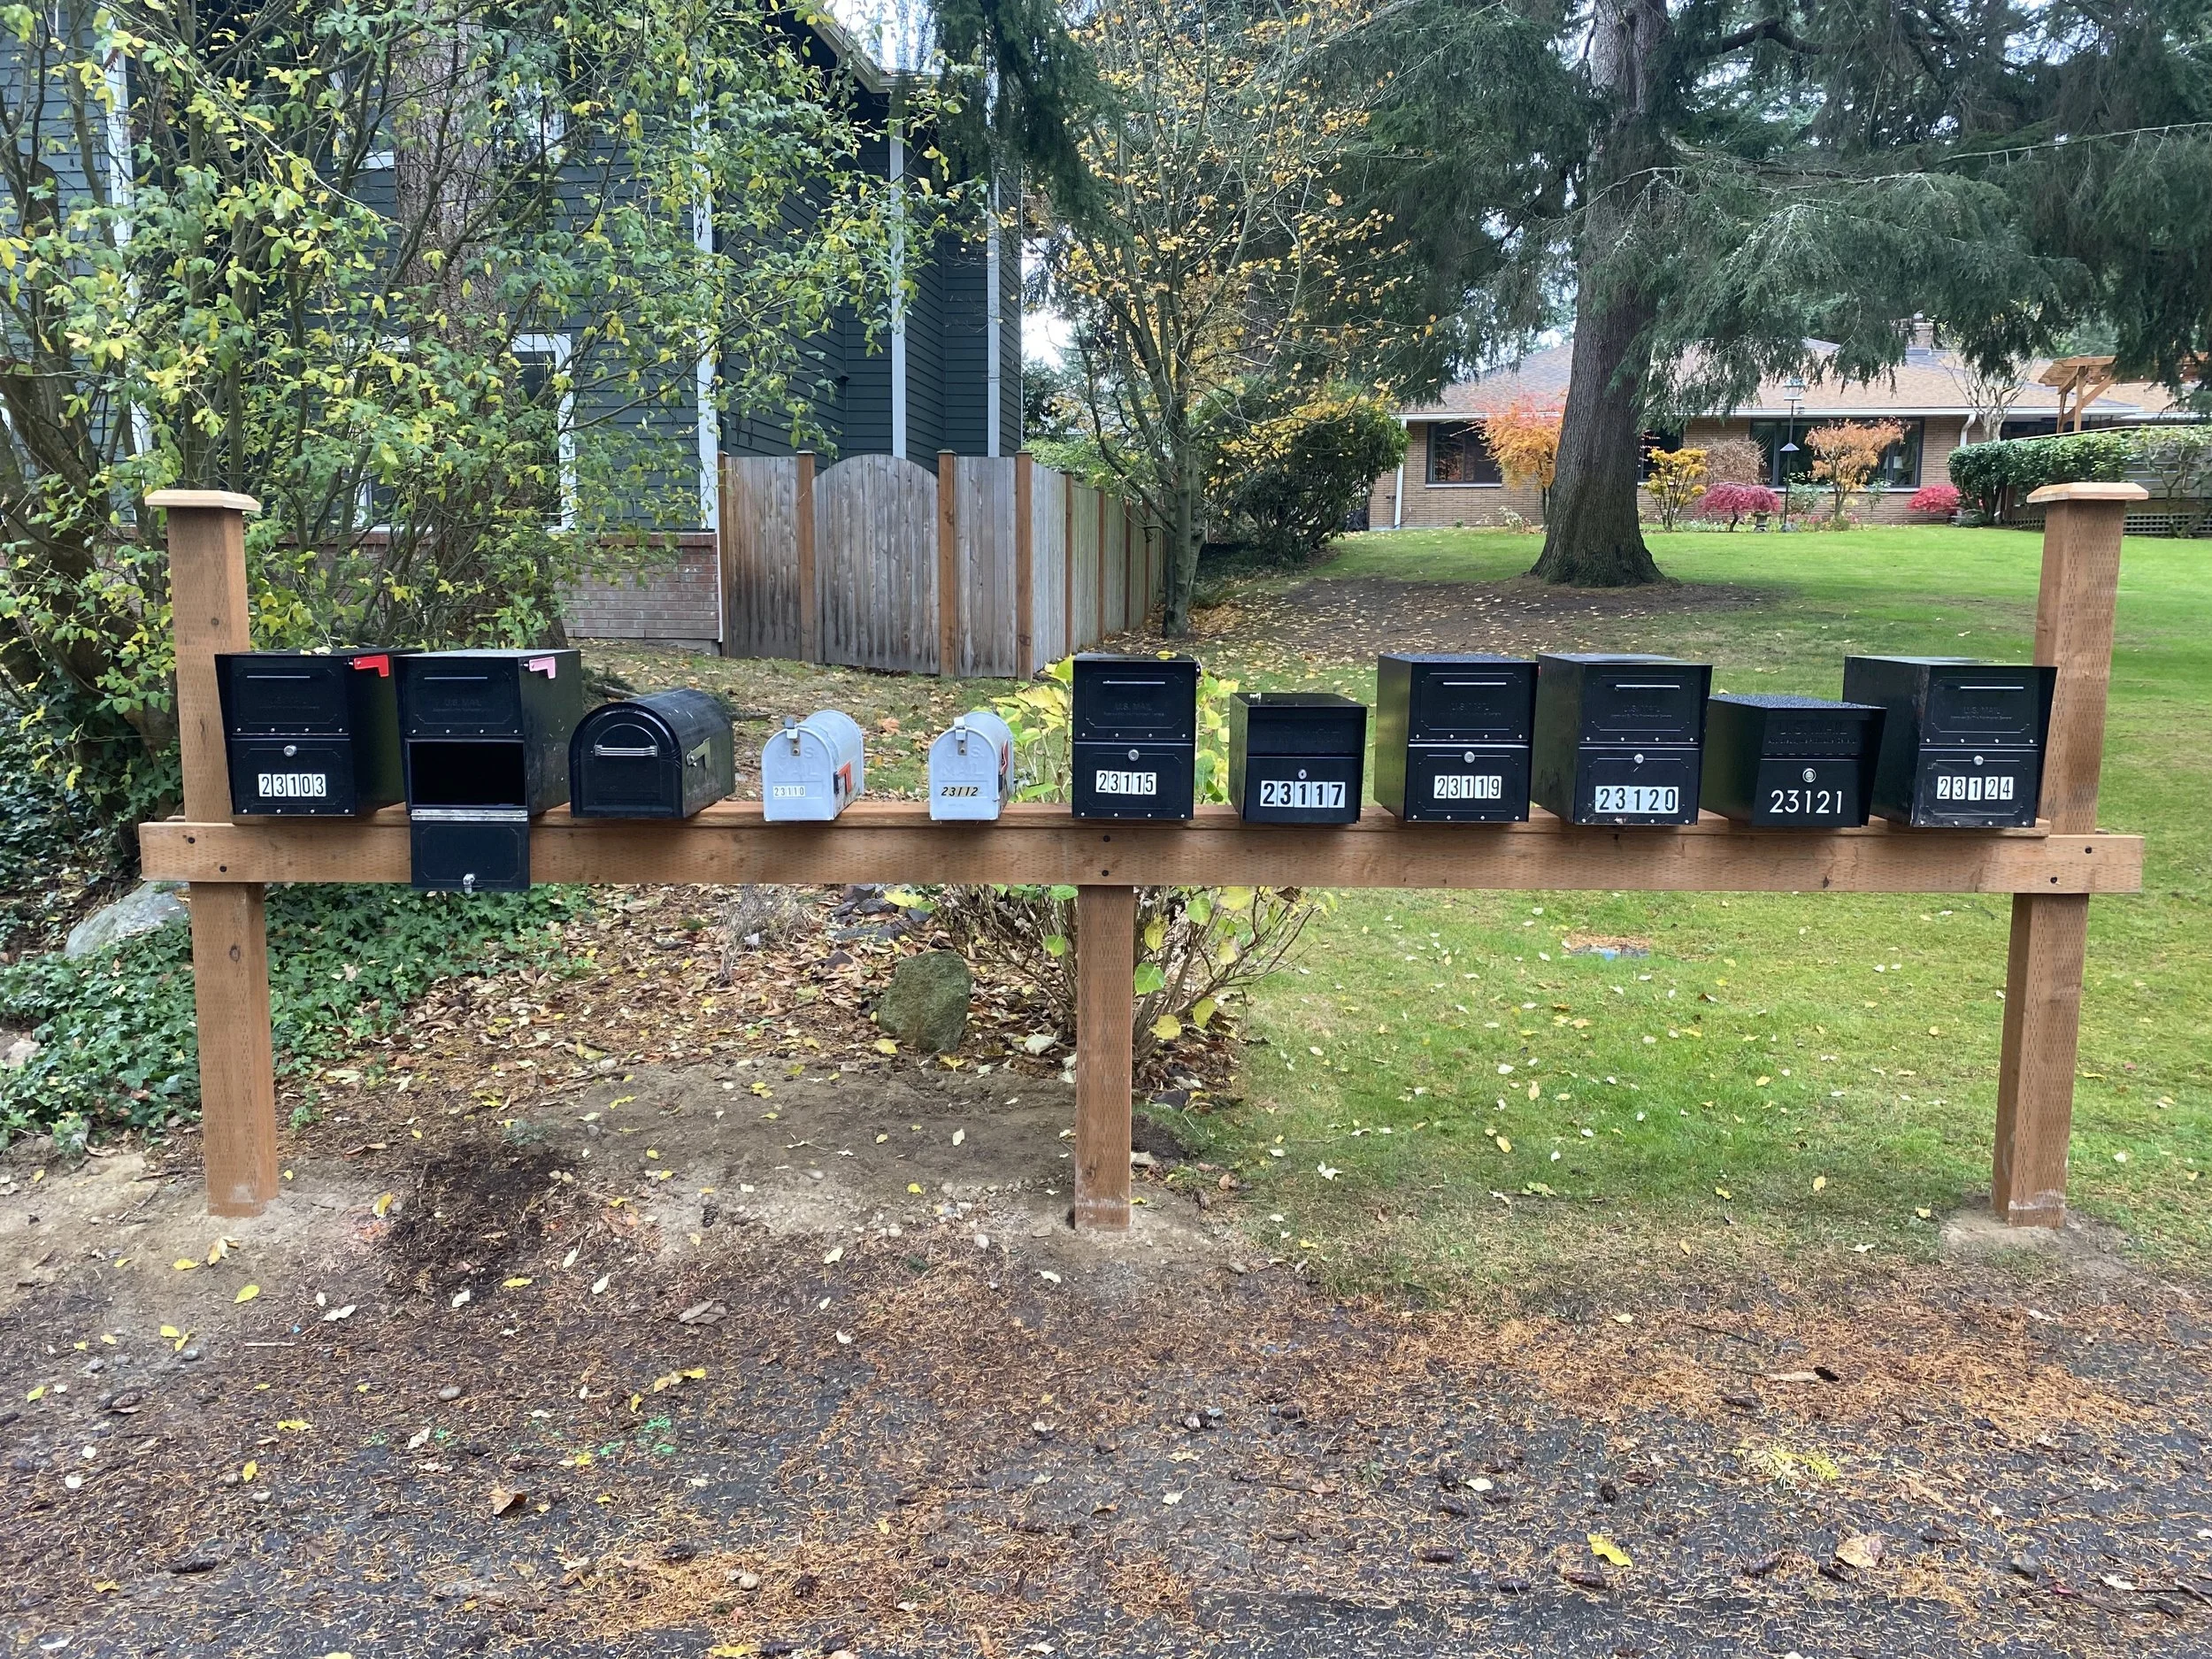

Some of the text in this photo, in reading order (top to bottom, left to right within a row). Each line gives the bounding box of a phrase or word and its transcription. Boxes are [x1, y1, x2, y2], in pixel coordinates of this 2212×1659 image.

[261, 776, 324, 795] 23103
[774, 787, 804, 796] 23110
[941, 787, 979, 796] 23112
[1098, 772, 1154, 793] 23115
[1436, 778, 1500, 797] 23119
[1939, 778, 2010, 798] 23124
[1263, 782, 1343, 806] 23117
[1599, 787, 1676, 811] 23120
[1769, 789, 1842, 814] 23121
